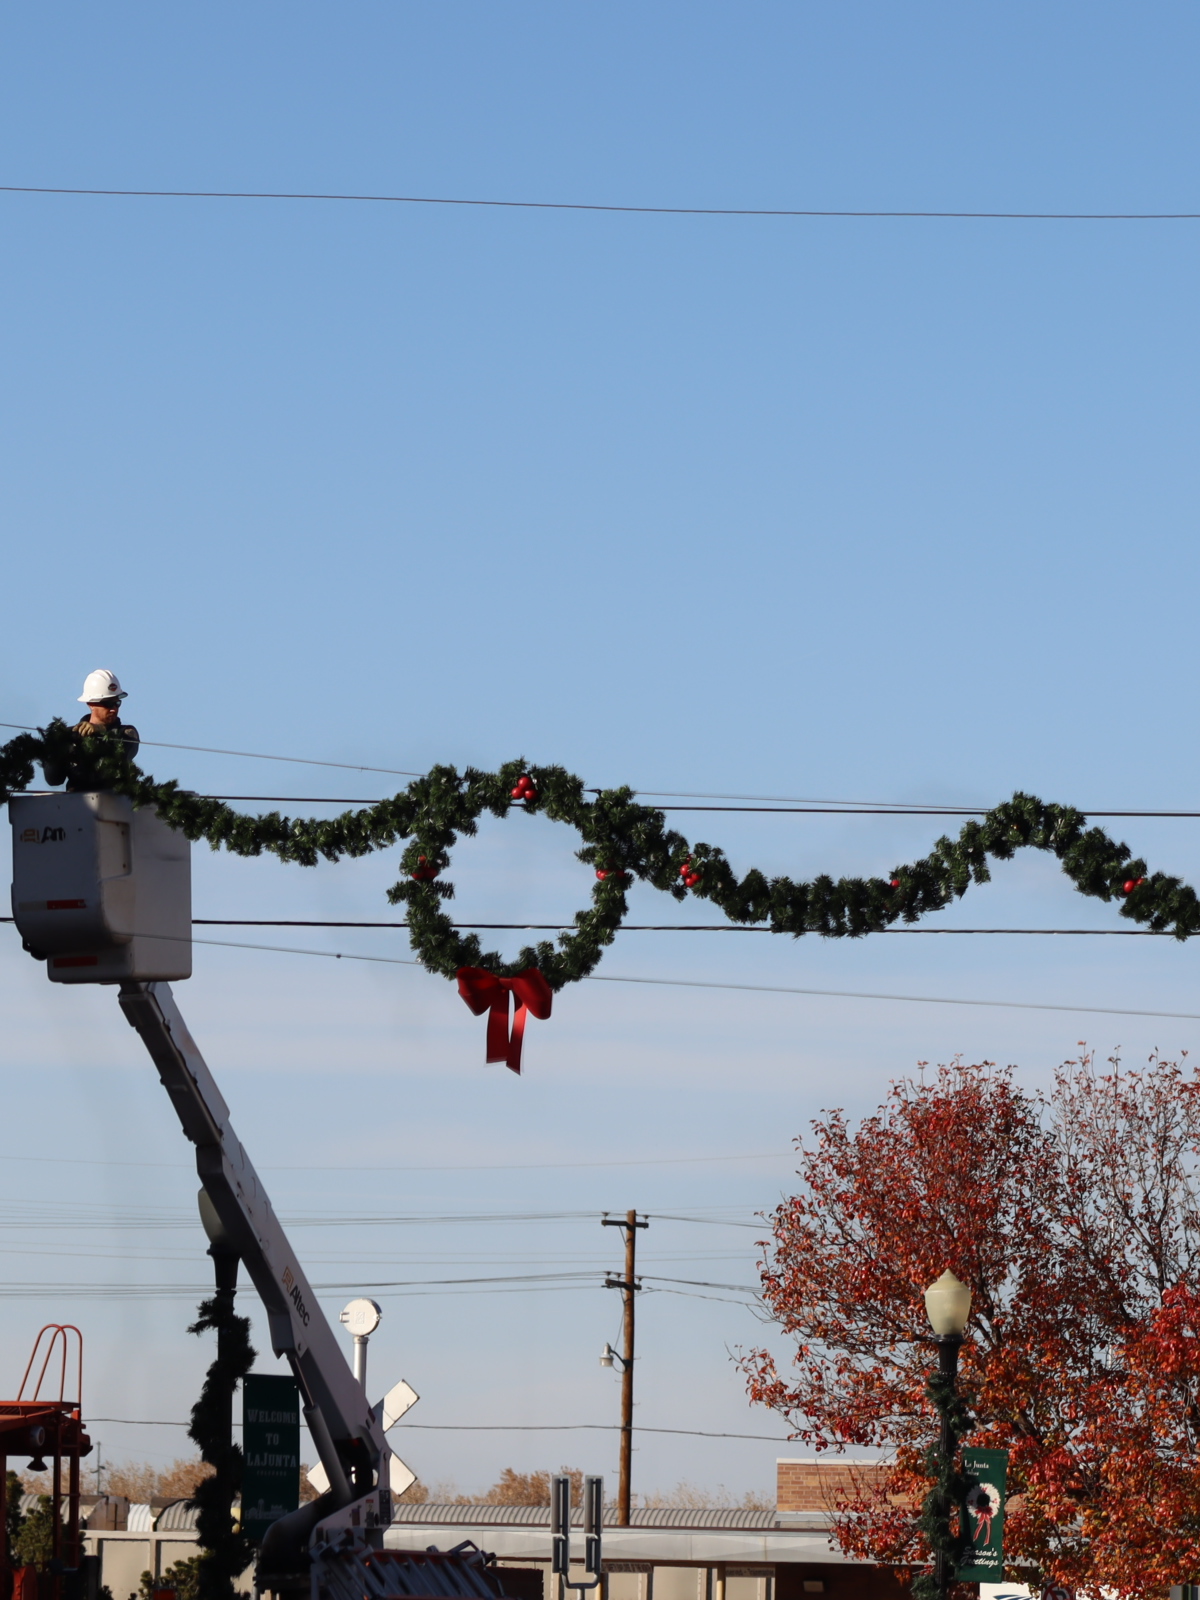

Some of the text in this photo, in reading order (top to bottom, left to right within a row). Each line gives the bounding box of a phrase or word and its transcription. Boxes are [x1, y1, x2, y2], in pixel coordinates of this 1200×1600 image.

[289, 1283, 310, 1327] Altec
[246, 1408, 297, 1424] WELCOME
[265, 1432, 280, 1446] TO
[962, 1546, 999, 1557] Season's
[959, 1554, 999, 1569] Greetings
